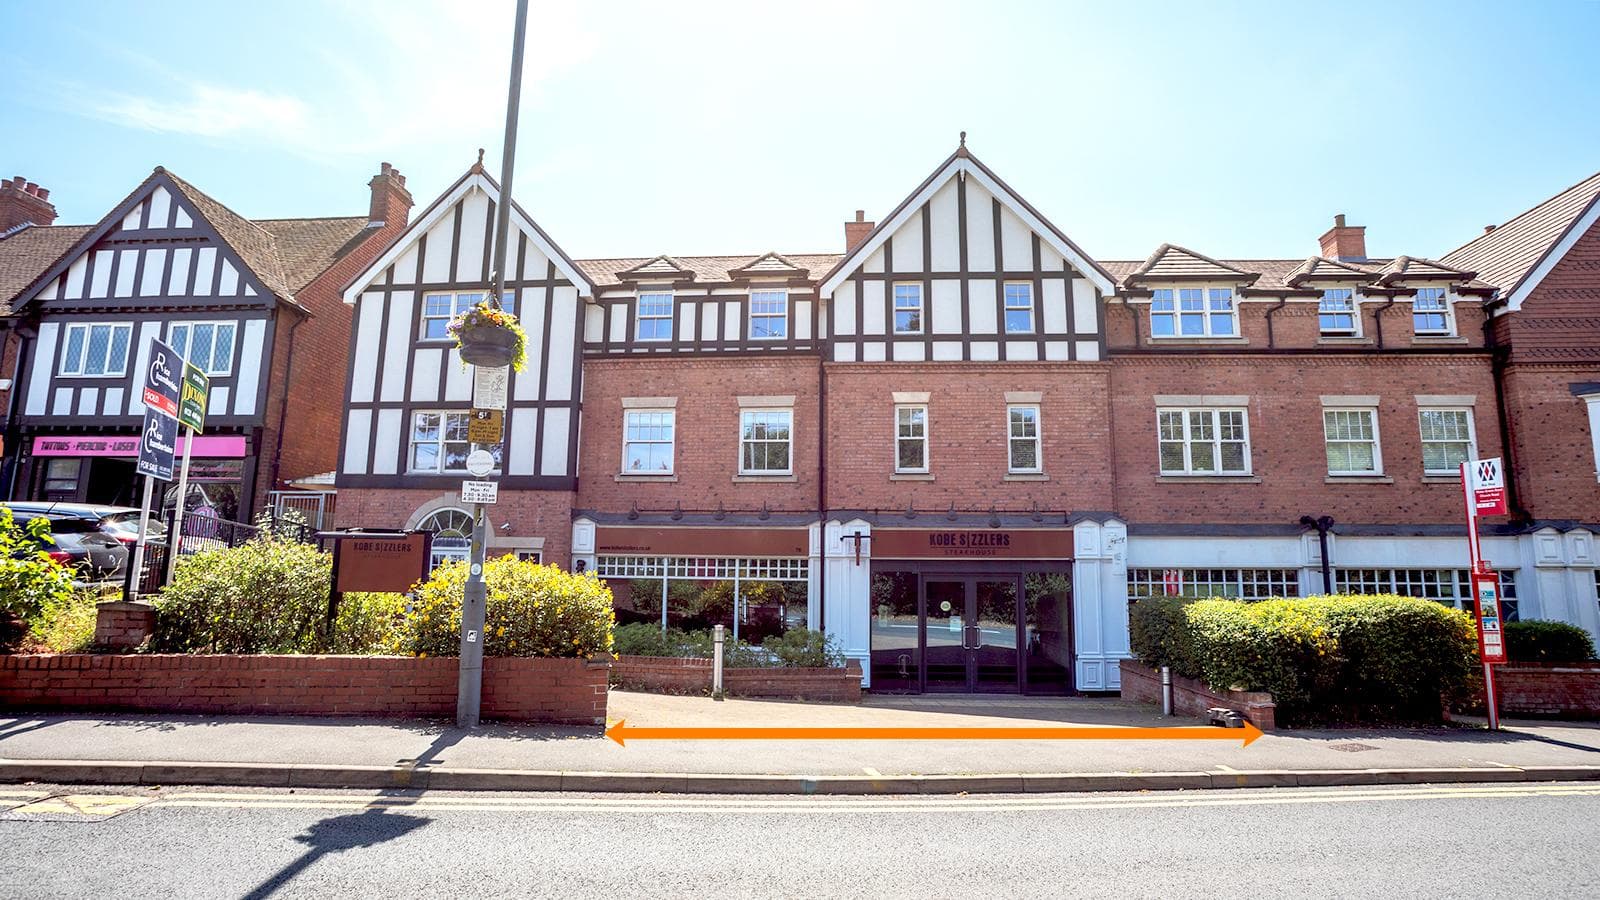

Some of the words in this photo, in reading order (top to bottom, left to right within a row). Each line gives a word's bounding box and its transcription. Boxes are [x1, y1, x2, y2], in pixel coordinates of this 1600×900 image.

[147, 392, 160, 403] SOLD
[150, 418, 163, 440] Rice
[929, 533, 956, 546] KOBE
[959, 531, 1010, 548] SIZZLERS
[353, 542, 374, 552] KOBE
[374, 542, 412, 553] SIZZLERS
